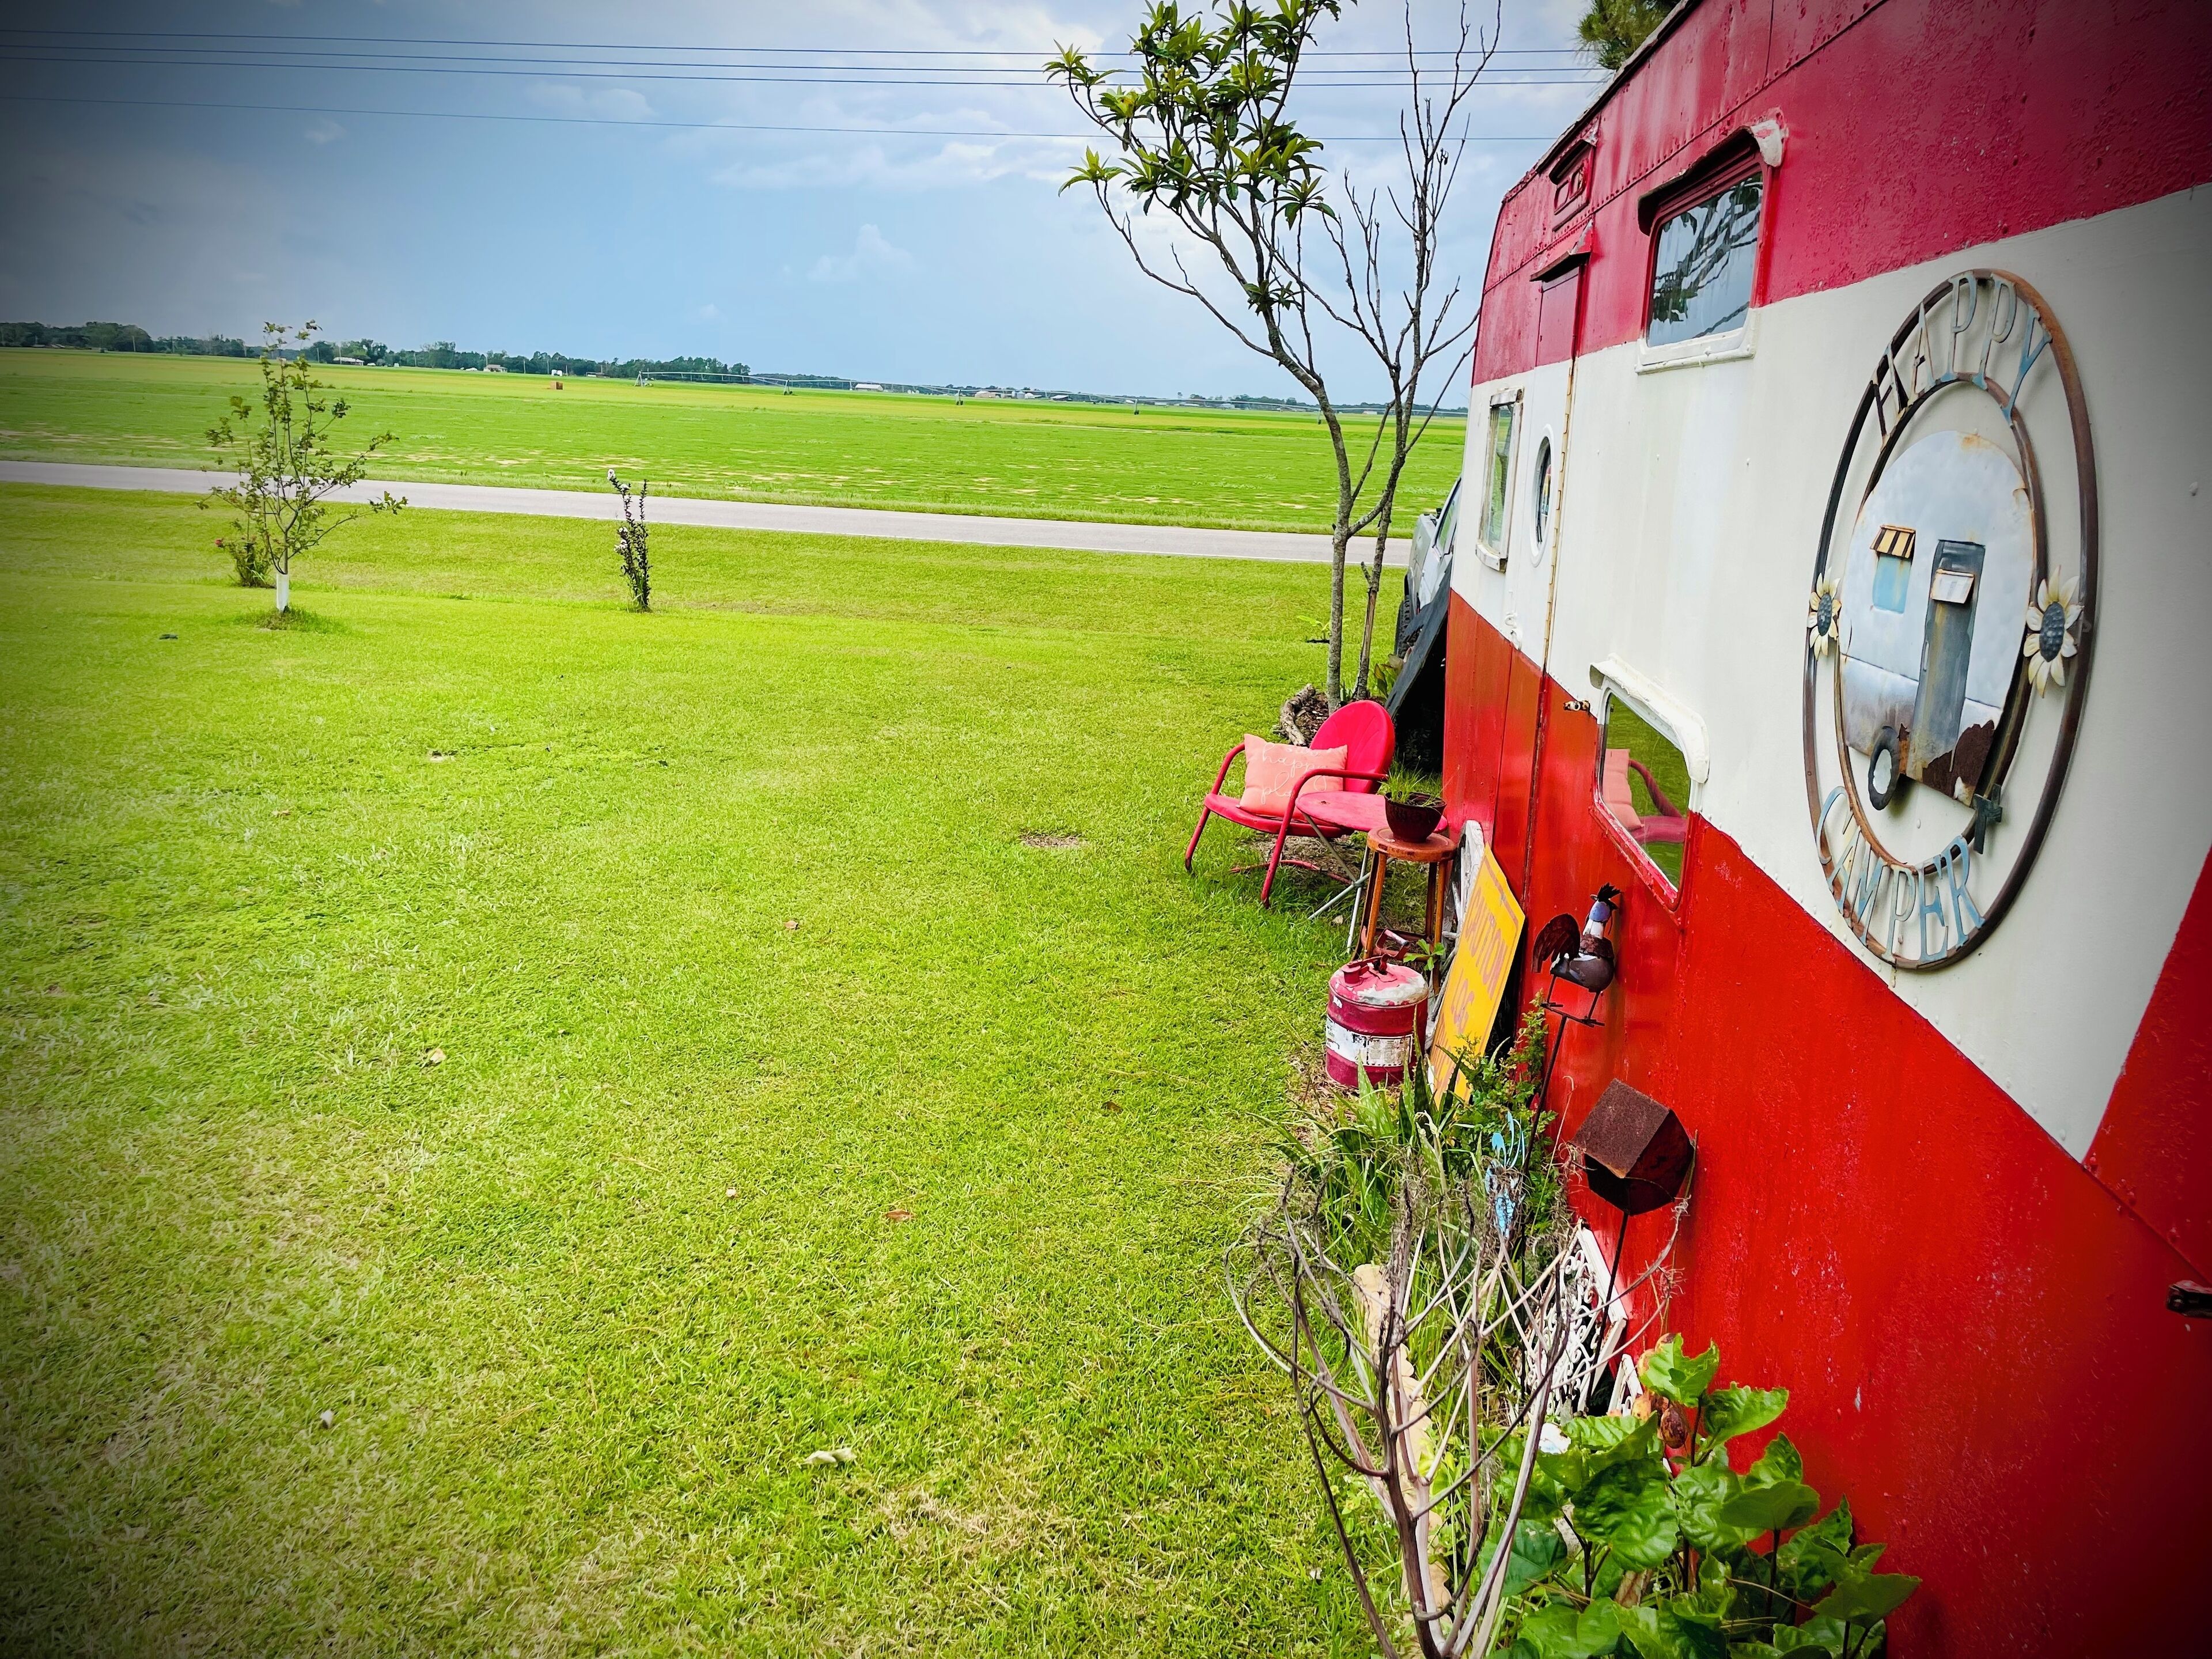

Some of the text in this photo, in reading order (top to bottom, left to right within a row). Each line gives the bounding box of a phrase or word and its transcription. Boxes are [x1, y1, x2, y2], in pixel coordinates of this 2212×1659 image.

[1870, 271, 2053, 452] HAPPY
[1464, 887, 1508, 1000] CAUTION
[1816, 785, 1986, 966] CAMPER
